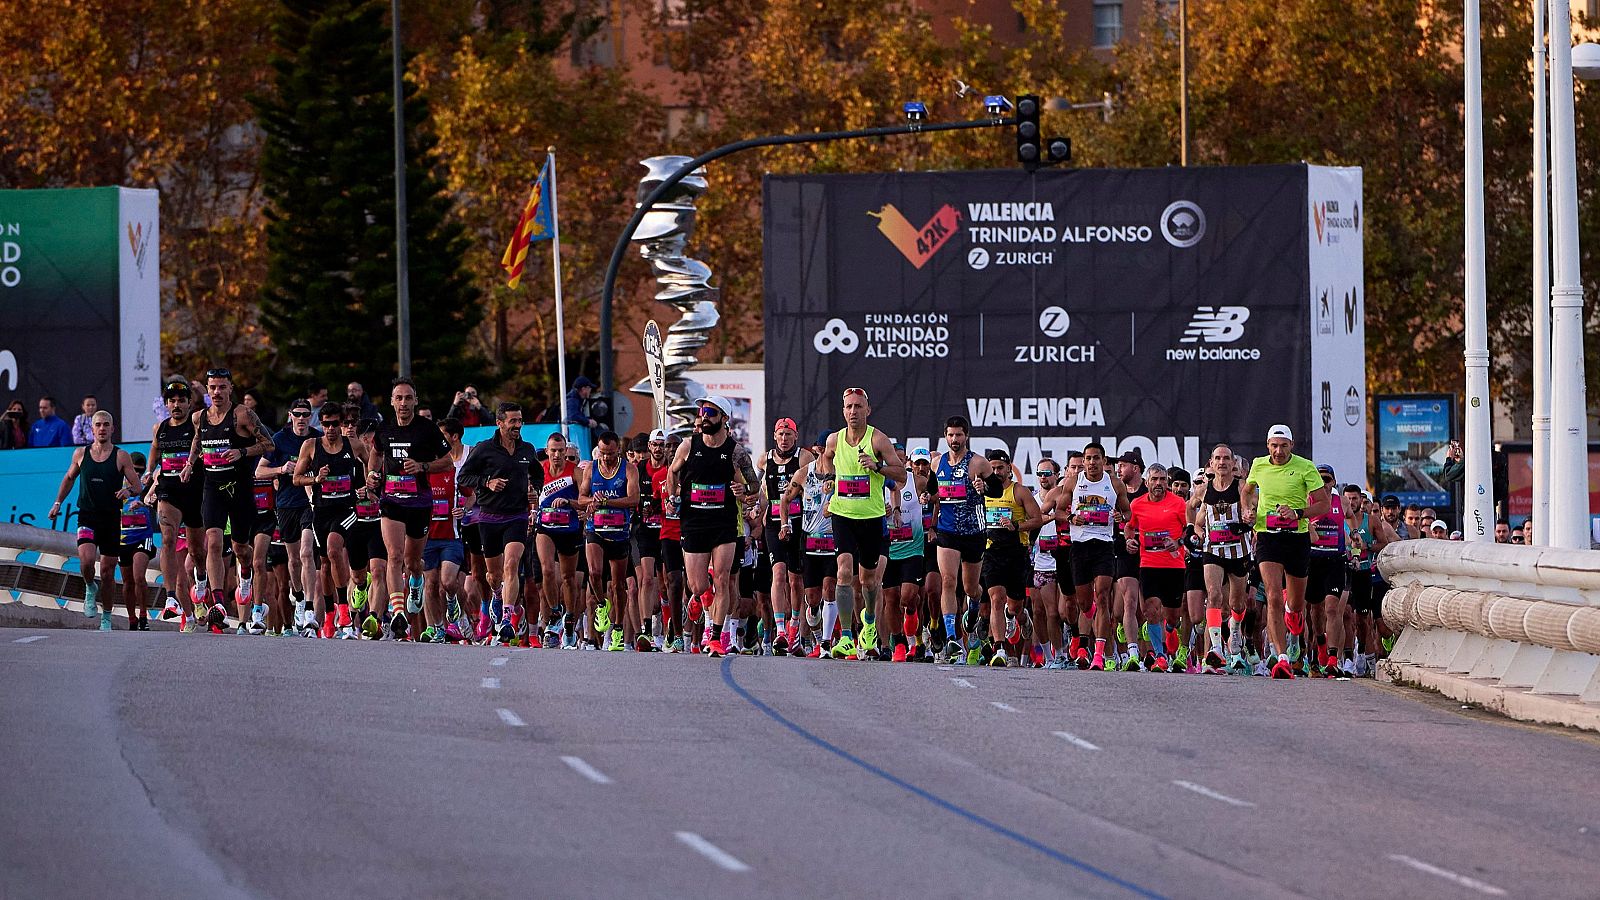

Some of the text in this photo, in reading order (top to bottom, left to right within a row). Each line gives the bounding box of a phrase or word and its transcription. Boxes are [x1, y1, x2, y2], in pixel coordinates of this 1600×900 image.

[968, 203, 1054, 222] VALENCIA
[916, 218, 949, 256] 42K
[968, 226, 1057, 243] TRINIDAD
[1061, 225, 1152, 243] ALFONSO
[996, 252, 1053, 265] ZURICH
[865, 312, 949, 324] FUNDACIÓN
[864, 327, 949, 342] TRINIDAD
[865, 343, 949, 358] ALFONSO
[1014, 346, 1095, 363] ZURICH
[1166, 346, 1260, 361] new balance
[966, 397, 1105, 427] VALENCIA
[543, 478, 566, 492] ATLETICA
